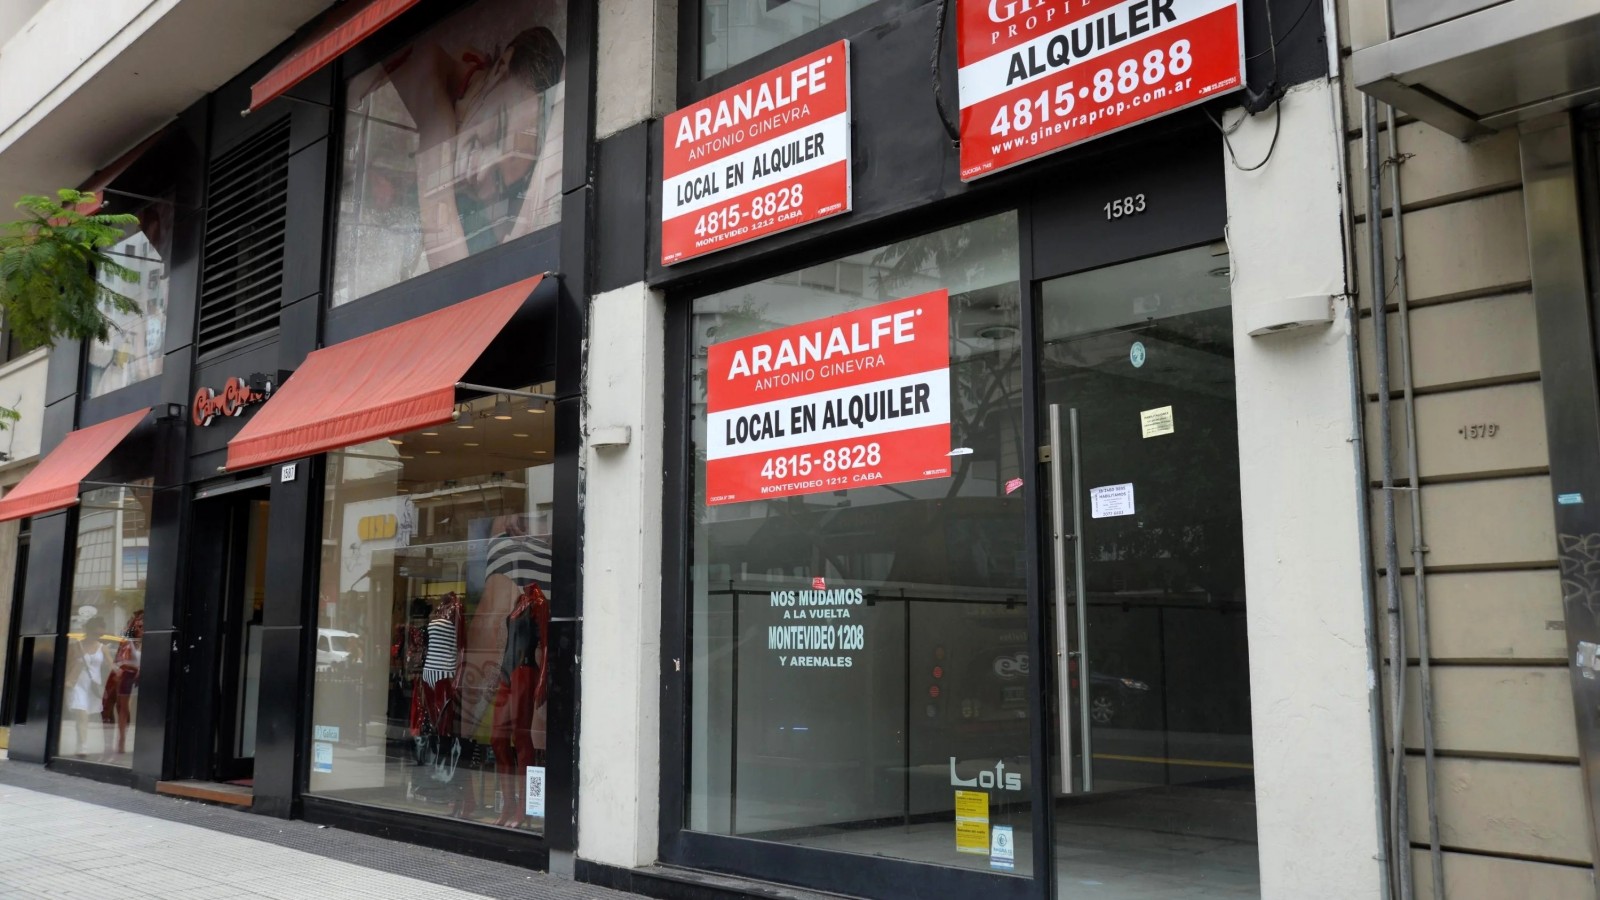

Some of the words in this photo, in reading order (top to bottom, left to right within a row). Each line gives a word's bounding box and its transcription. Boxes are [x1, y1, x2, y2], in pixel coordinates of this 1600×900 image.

[1006, 0, 1177, 86] ALQUILER
[675, 57, 827, 148] ARANALFE
[991, 77, 1193, 155] www.ginevraprop.com.ar
[689, 130, 745, 161] ANTONIO
[749, 104, 811, 137] GINEVRA
[677, 172, 719, 206] LOCAL
[726, 162, 744, 189] EN
[752, 132, 825, 180] ALQUILER
[694, 184, 804, 237] 4815-8828
[1104, 193, 1146, 220] 1583
[695, 226, 748, 247] MONTEVIDEO
[751, 218, 775, 231] 1212
[778, 210, 803, 222] CABA
[727, 309, 916, 380] ARANALFE
[755, 368, 815, 391] ANTONIO
[820, 354, 885, 378] GINEVRA
[726, 410, 784, 445] LOCAL
[791, 403, 816, 435] EN
[822, 383, 930, 430] ALQUILER
[1463, 423, 1497, 440] 1579
[283, 467, 294, 479] 1587
[760, 443, 881, 480] 4815-8828
[761, 479, 823, 493] MONTEVIDEO
[826, 476, 848, 485] 1212
[853, 472, 882, 482] CABA
[770, 590, 795, 607] NOS
[799, 588, 863, 606] MUDAMOS
[783, 610, 791, 619] A
[794, 610, 806, 619] LA
[809, 609, 850, 619] VUELTA
[769, 625, 835, 650] MONTEVIDEO
[838, 625, 864, 650] 1208
[779, 656, 787, 666] Y
[790, 656, 853, 667] ARENALES
[950, 757, 1022, 790] Lots
